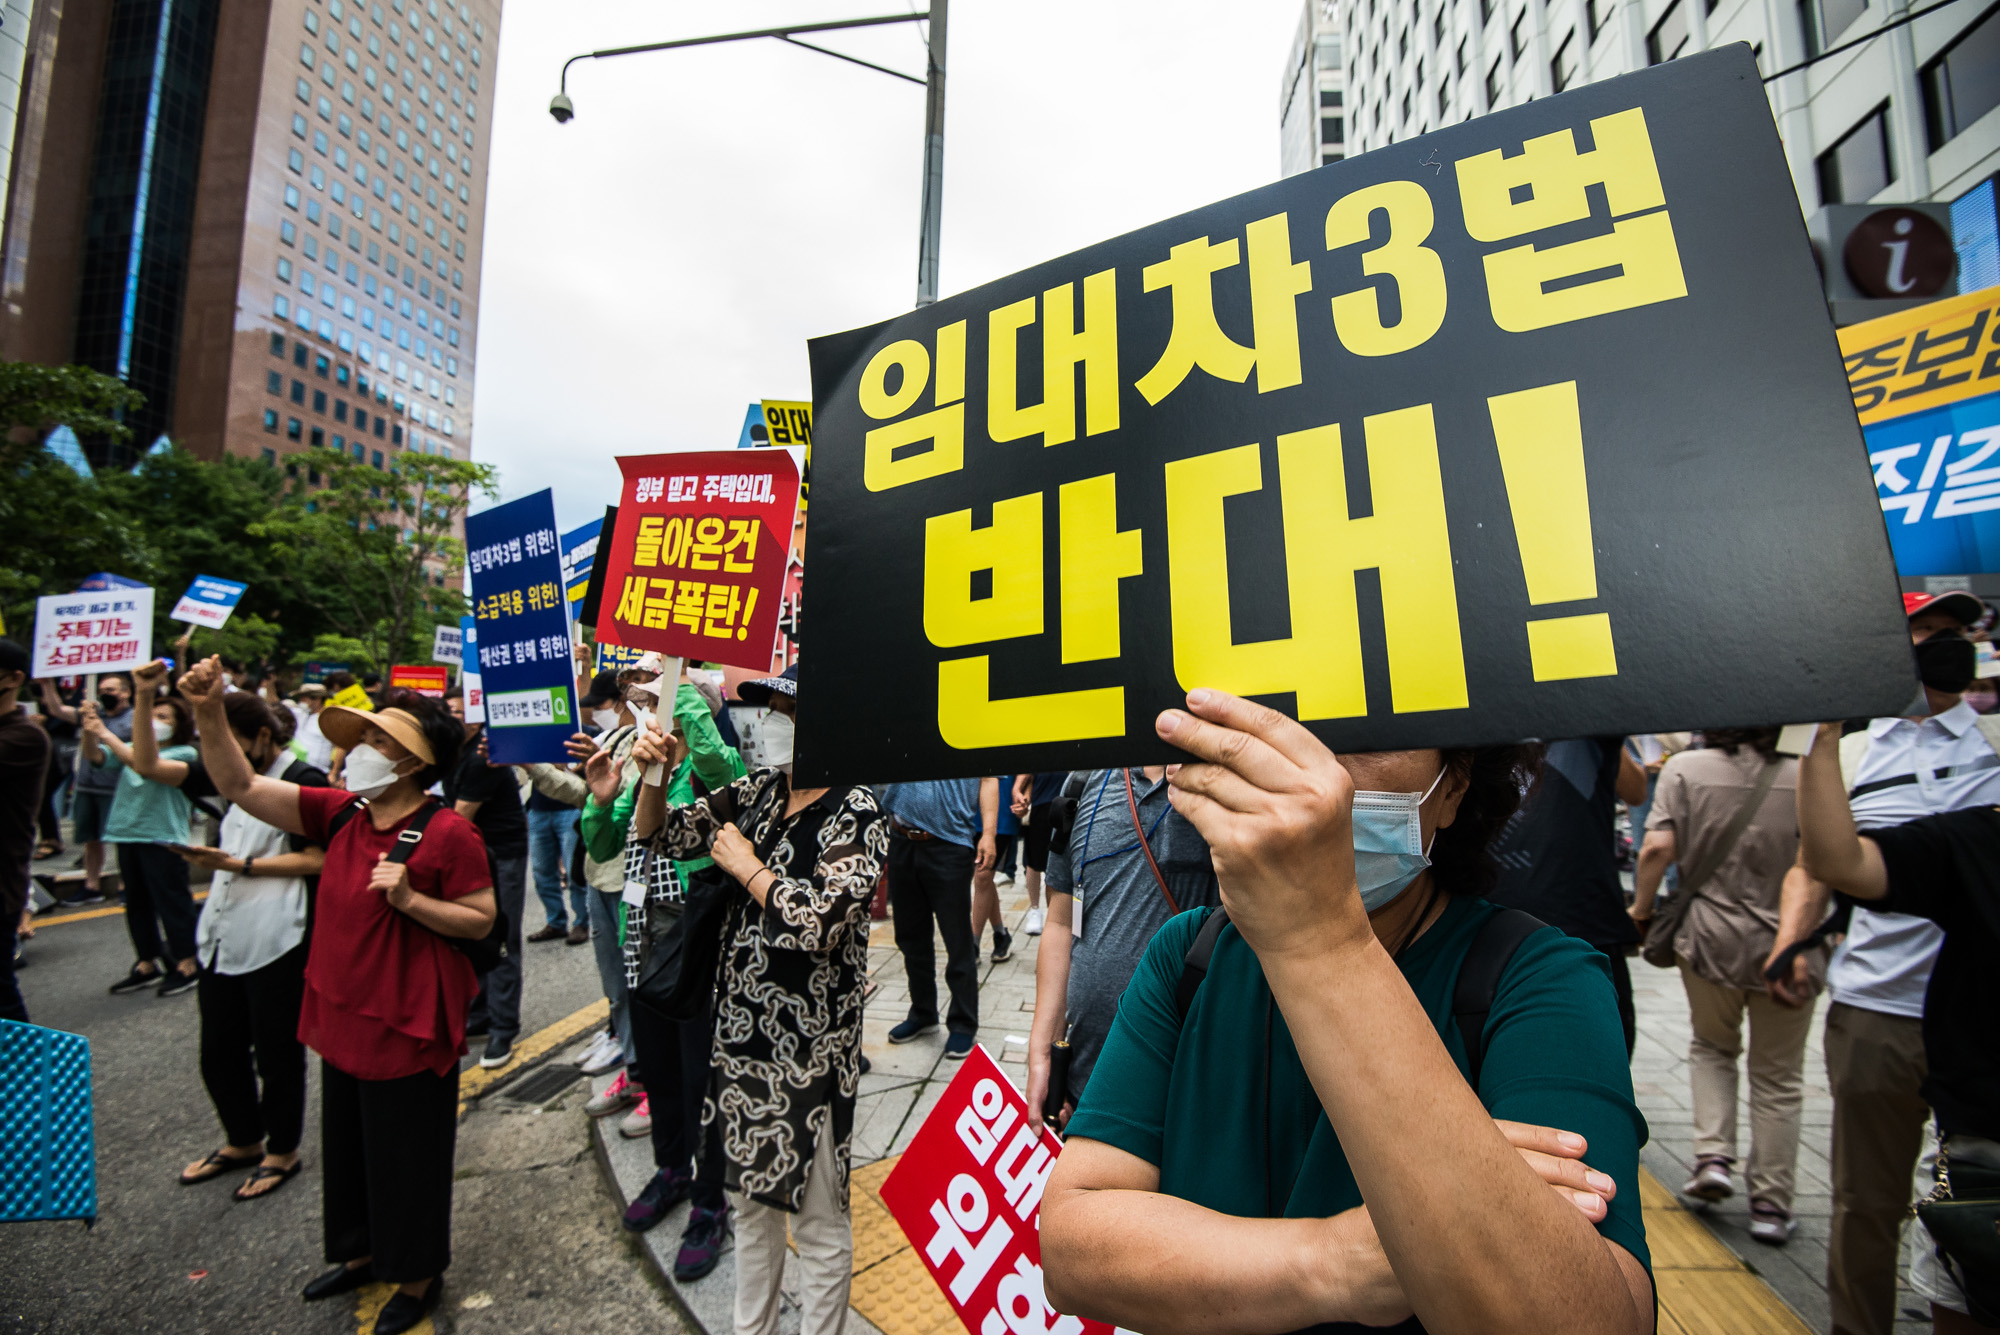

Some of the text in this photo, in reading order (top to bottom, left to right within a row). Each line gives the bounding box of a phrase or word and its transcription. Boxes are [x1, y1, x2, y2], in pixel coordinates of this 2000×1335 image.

[859, 108, 1687, 492] 임대차3법
[1844, 308, 2000, 413] 증보
[635, 476, 665, 503] 정부
[667, 475, 699, 503] 믿고
[702, 473, 776, 504] 주택임대,
[470, 537, 523, 574] 임대차3법
[525, 528, 555, 558] 위헌!
[633, 516, 761, 574] 돌아온건
[923, 381, 1618, 749] 반대!
[477, 589, 524, 620] 소급적용
[528, 581, 560, 611] 위헌!
[614, 576, 760, 642] 세금폭탄!
[56, 618, 132, 641] 주특기는
[480, 634, 569, 668] 재산권 침해 위헌!
[46, 640, 139, 666] 소급입법!!
[491, 701, 530, 720] 임대차3법
[532, 698, 551, 717] 반대
[955, 1078, 1058, 1230] 임대
